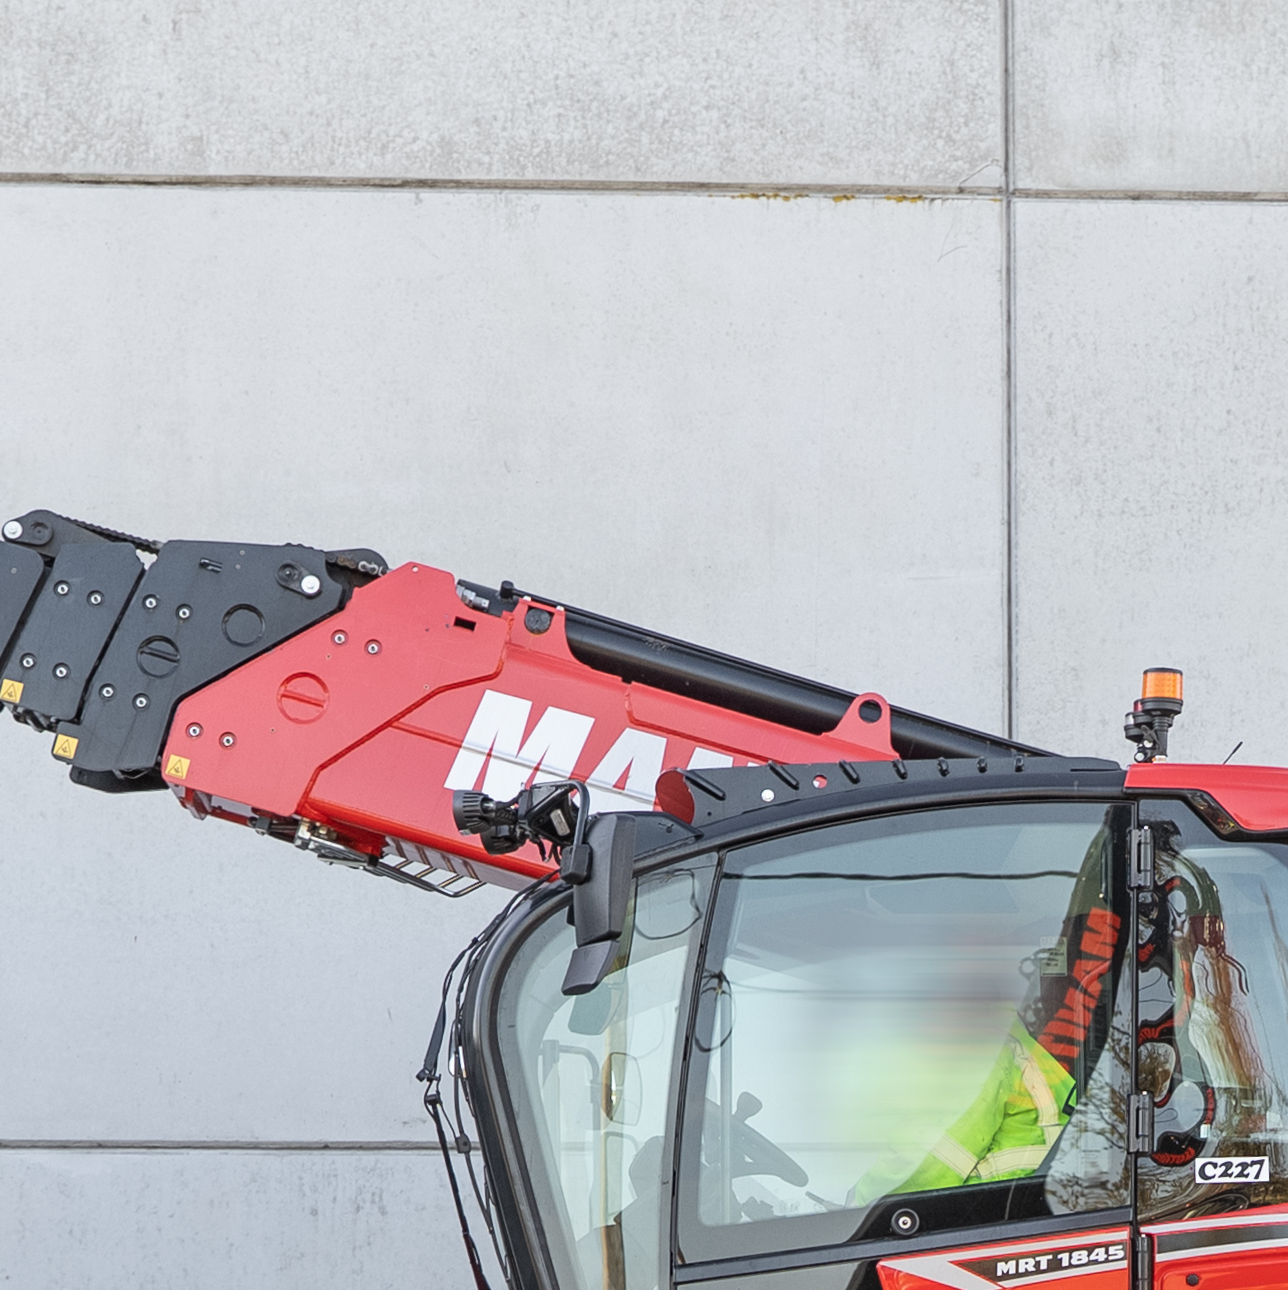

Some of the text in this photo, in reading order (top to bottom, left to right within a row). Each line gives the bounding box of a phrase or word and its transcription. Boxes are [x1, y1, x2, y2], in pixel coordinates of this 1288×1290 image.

[444, 689, 759, 815] MA
[1198, 1159, 1265, 1180] C227
[996, 1245, 1125, 1276] MRT 1845
